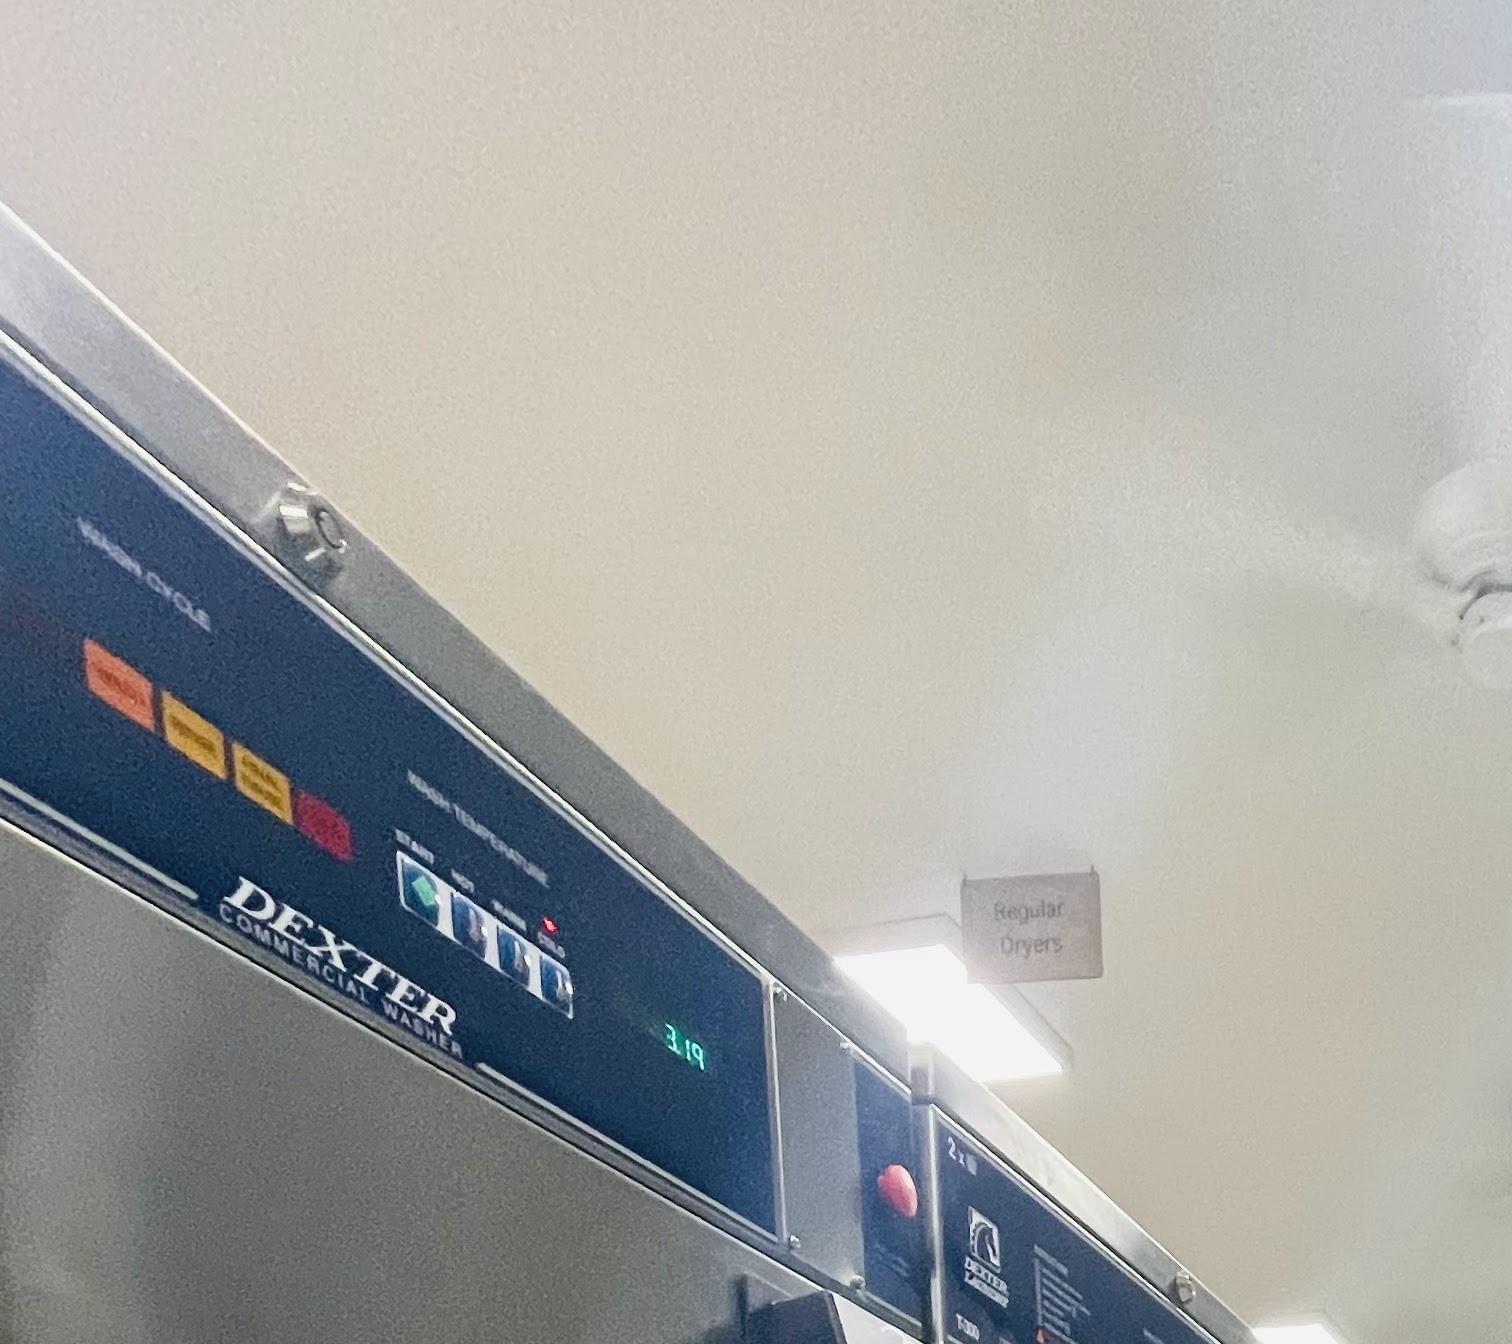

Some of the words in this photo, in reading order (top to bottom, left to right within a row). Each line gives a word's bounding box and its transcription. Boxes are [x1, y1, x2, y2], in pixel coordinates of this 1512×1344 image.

[146, 570, 211, 632] CYCLE
[993, 898, 1065, 925] Regular
[223, 875, 457, 1036] DEXTER
[1000, 934, 1063, 960] Dryers
[218, 902, 368, 1007] COMMERCIAL
[381, 998, 463, 1059] WASHER
[964, 1255, 1009, 1297] DEXTER
